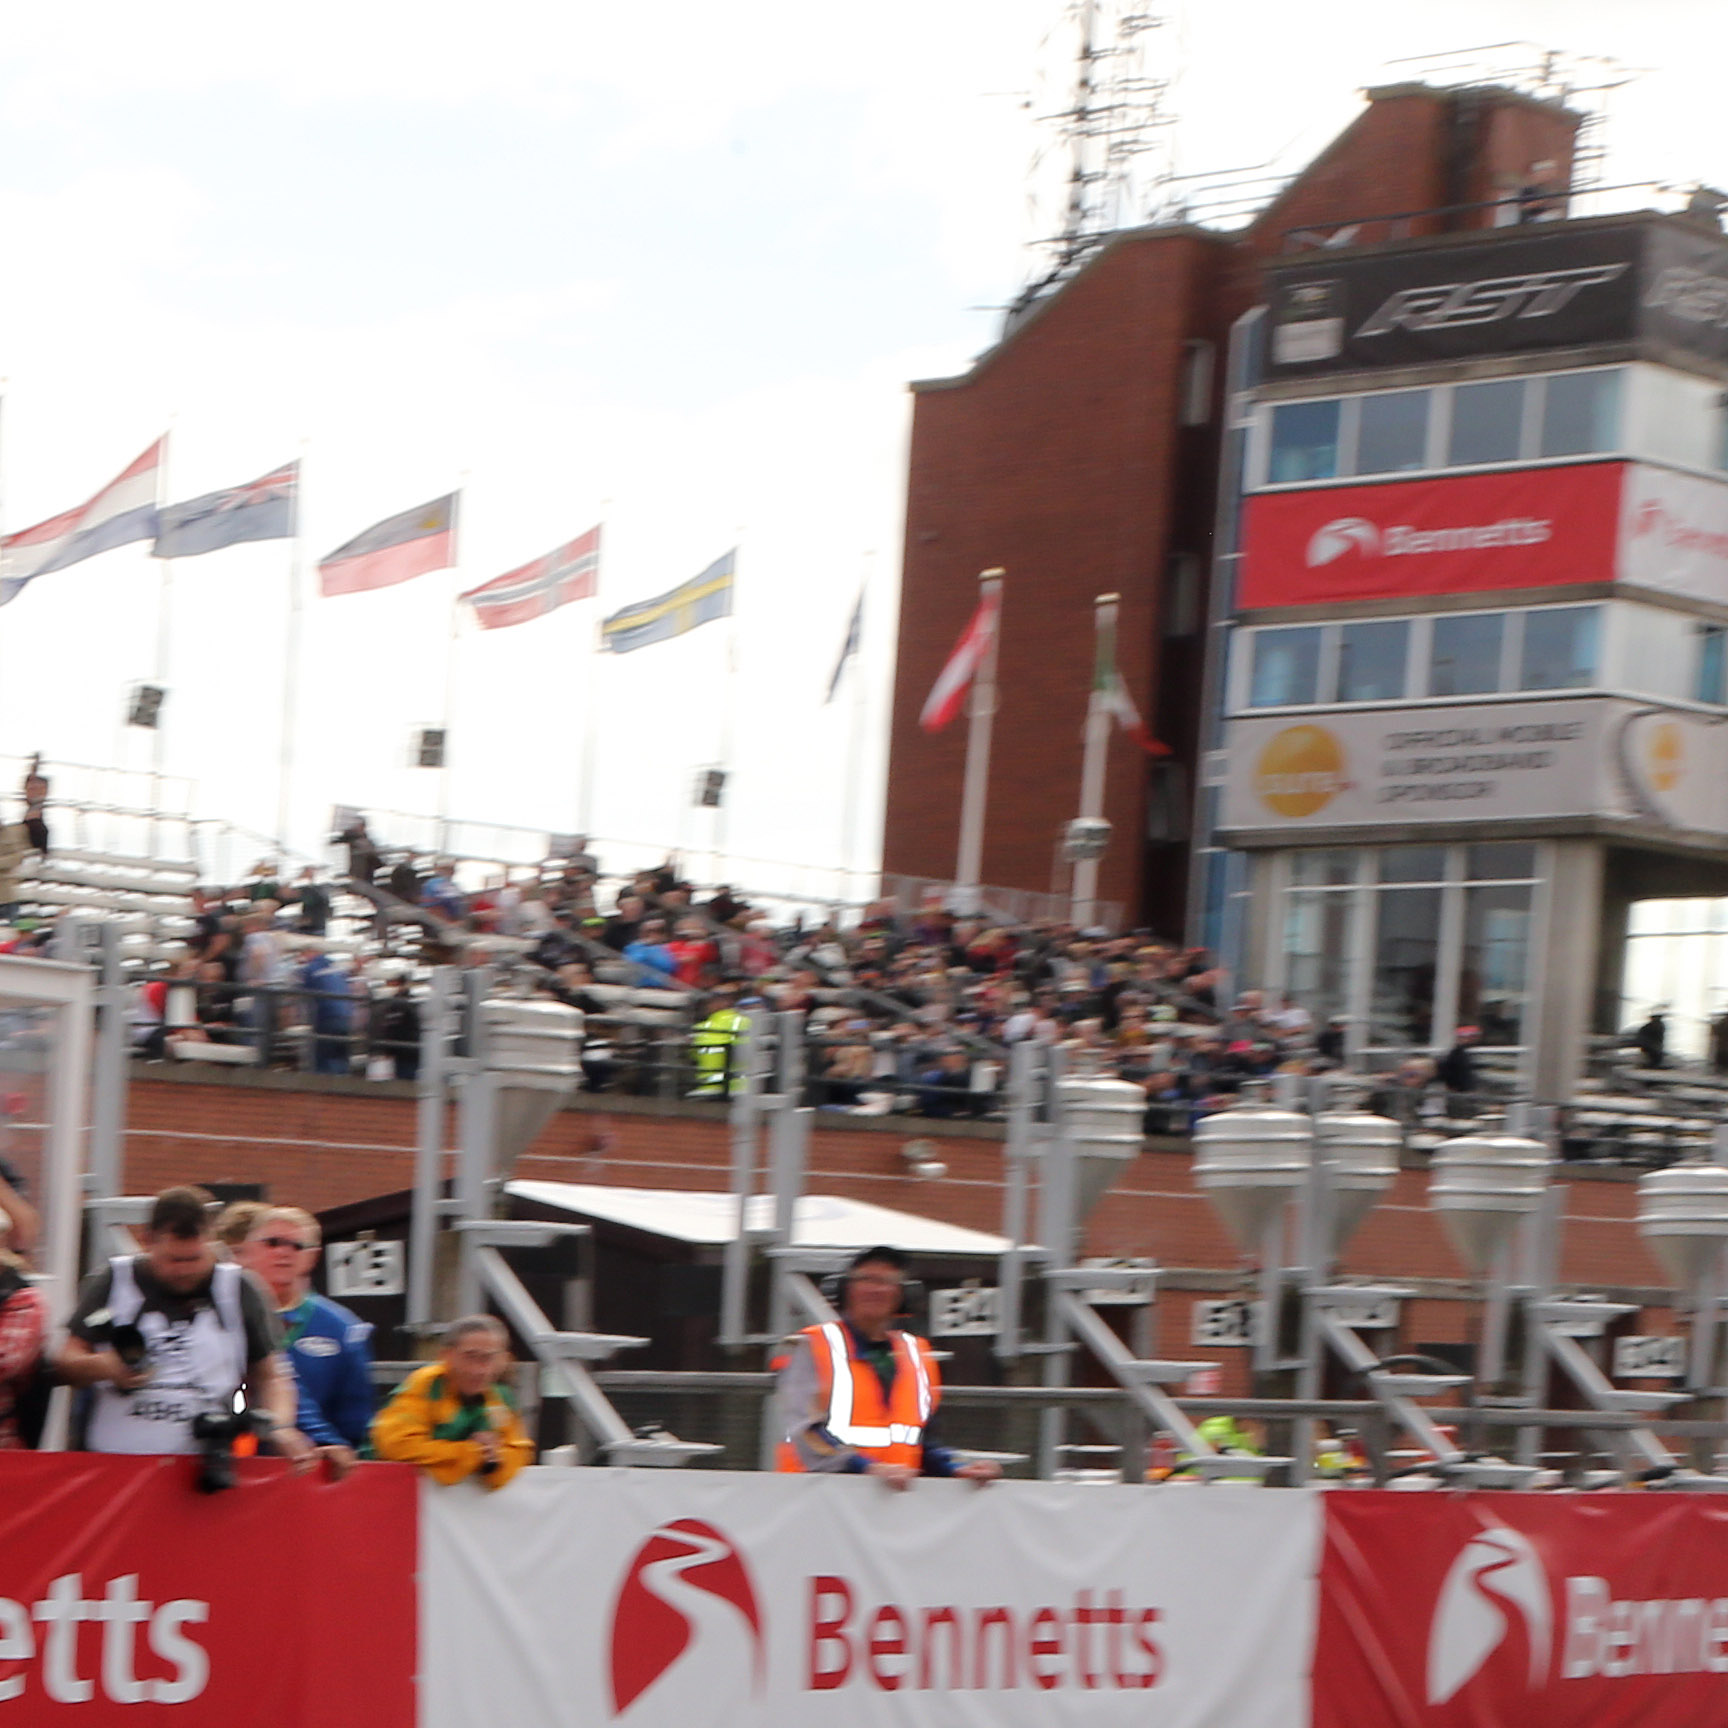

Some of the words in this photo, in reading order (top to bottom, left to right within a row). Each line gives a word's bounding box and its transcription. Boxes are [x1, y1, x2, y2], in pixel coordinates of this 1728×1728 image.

[1354, 263, 1631, 338] RST
[1383, 517, 1552, 556] Bennetts
[803, 1574, 1166, 1690] Bennetts
